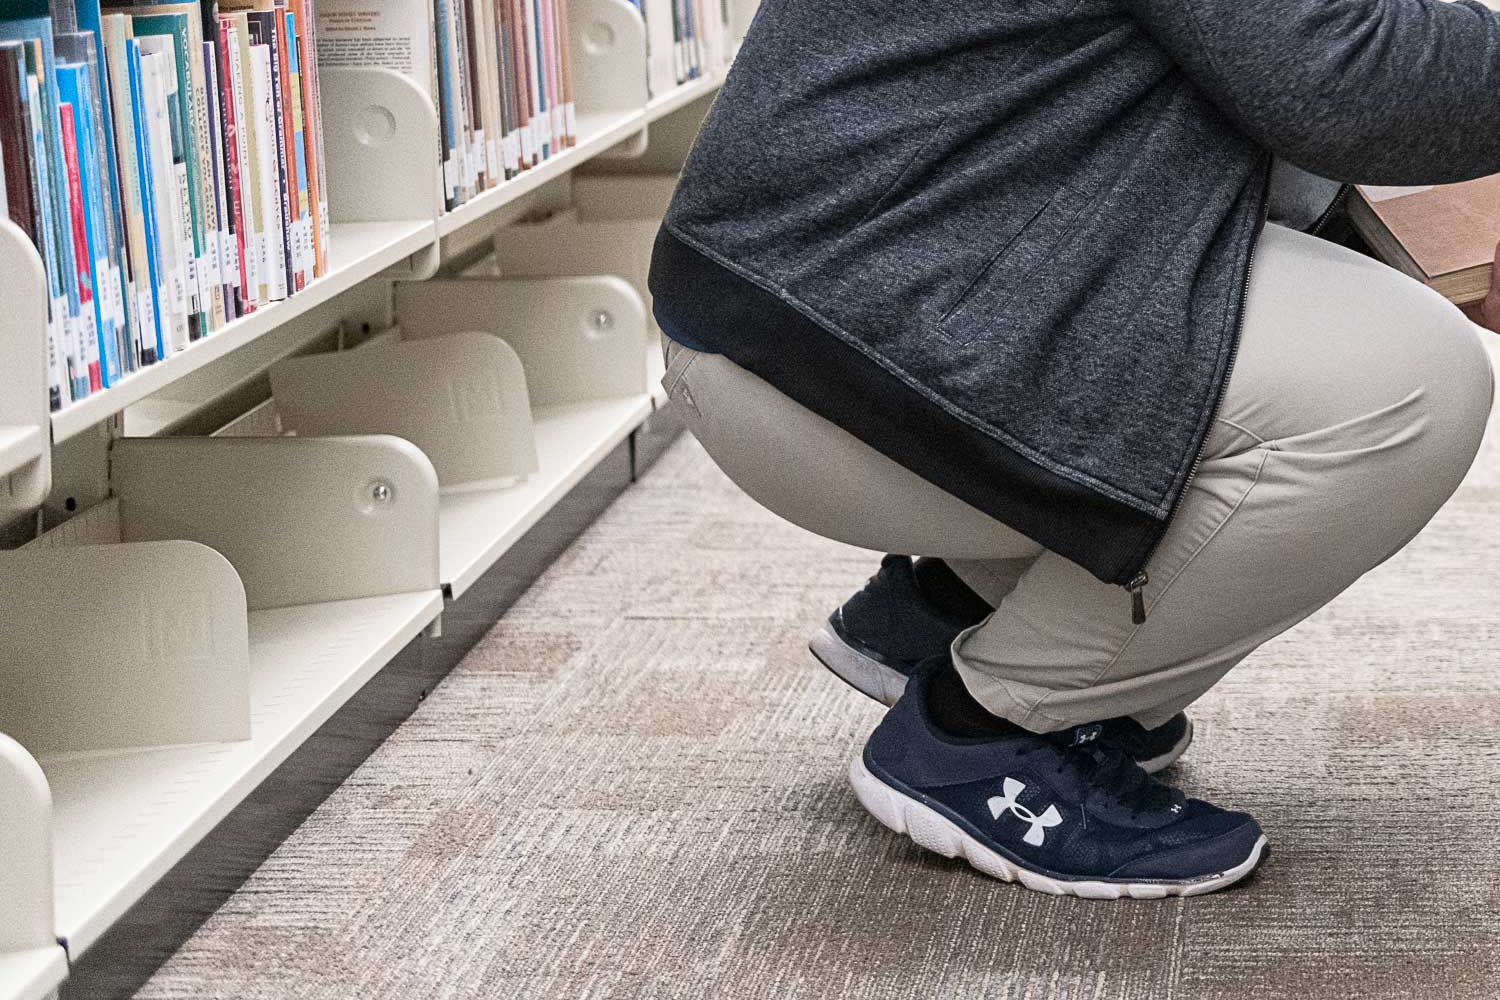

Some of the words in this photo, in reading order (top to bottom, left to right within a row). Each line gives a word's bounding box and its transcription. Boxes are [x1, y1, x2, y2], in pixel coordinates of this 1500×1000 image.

[182, 27, 194, 128] VOCABULARY
[196, 88, 204, 152] COLLEGE
[202, 157, 210, 230] VOCABULA
[200, 87, 209, 156] BUILDING
[283, 192, 291, 251] Bradshaw
